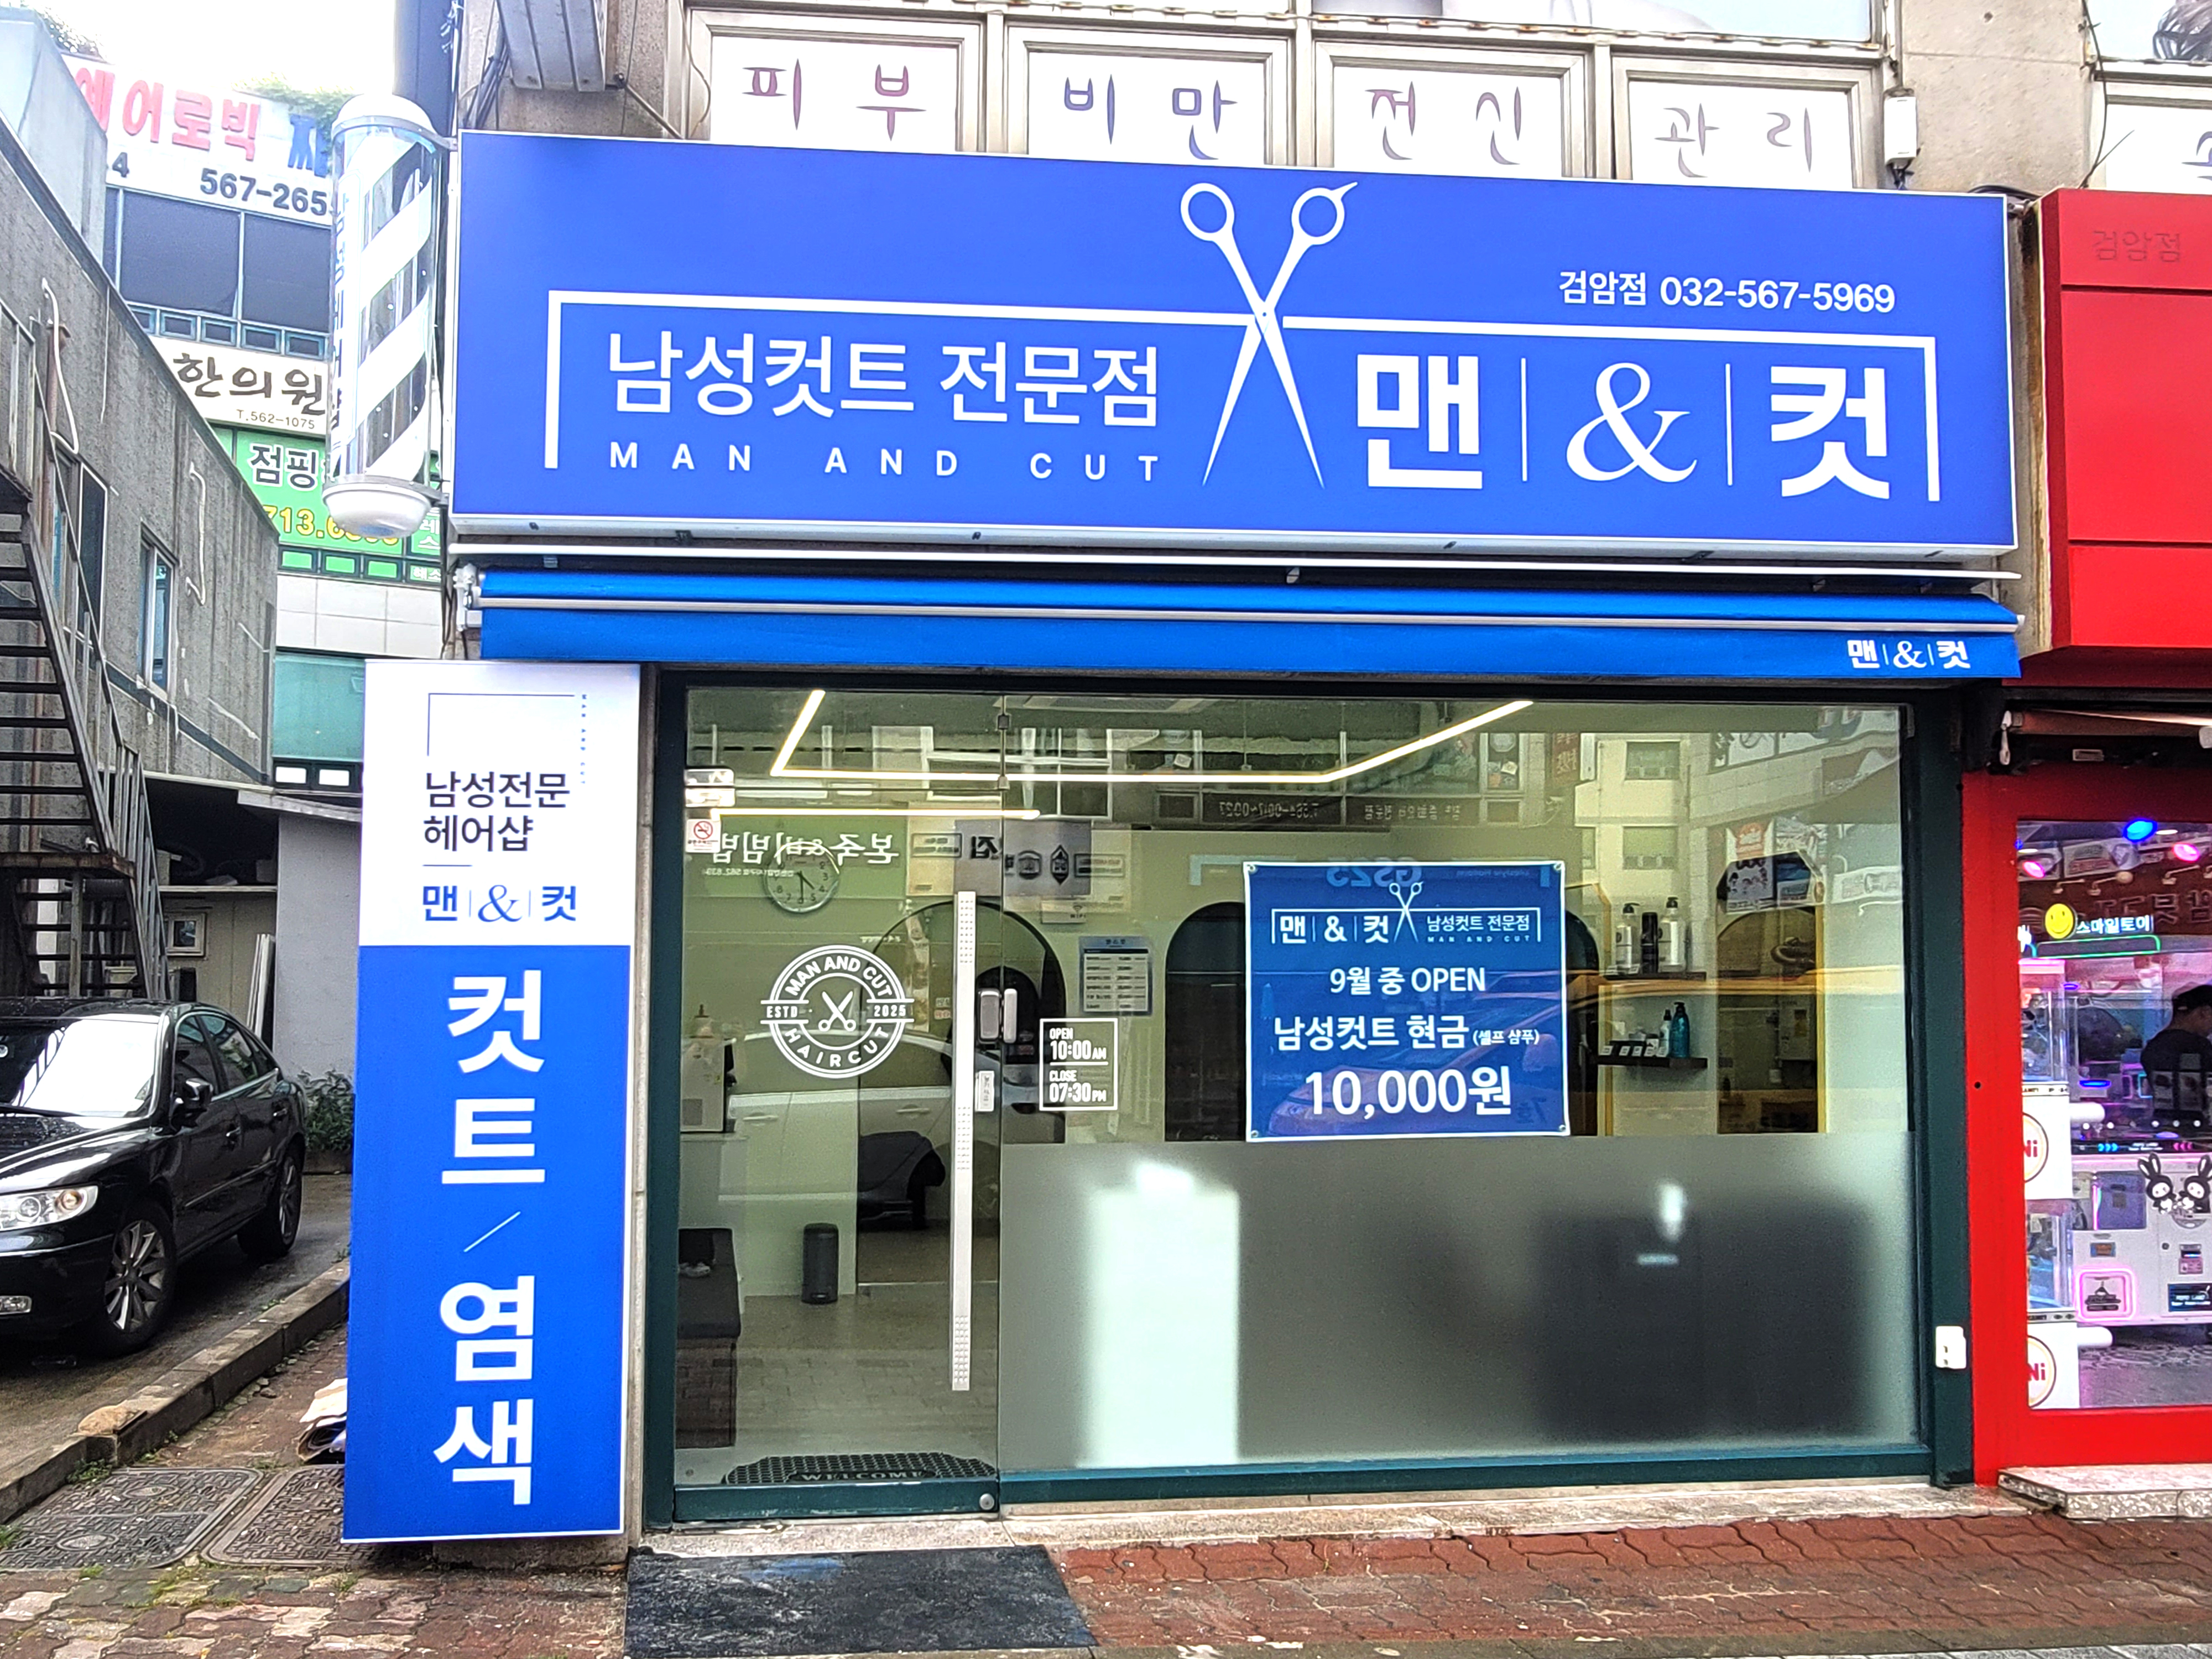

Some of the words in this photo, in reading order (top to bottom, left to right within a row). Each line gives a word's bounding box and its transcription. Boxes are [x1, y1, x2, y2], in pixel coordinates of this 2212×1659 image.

[743, 59, 926, 141] 피부
[1063, 74, 1238, 160] 비만
[1365, 81, 1522, 165] 전신
[1655, 103, 1812, 178] 관리
[200, 168, 331, 217] 567-265
[1559, 270, 1646, 305] 검암점
[1660, 276, 1895, 313] 032-567-5969
[173, 352, 326, 416] 한의원
[236, 408, 316, 430] T.562-1075
[609, 331, 914, 418] 남성컷트
[940, 342, 1156, 426] 전문점
[1357, 354, 1483, 489] 맨
[1567, 362, 1697, 482] &
[1771, 366, 1890, 499] 컷
[250, 444, 325, 490] 점핑
[610, 441, 750, 471] MAN
[825, 447, 957, 476] AND
[1030, 453, 1158, 481] CUT
[1847, 640, 1880, 669] 맨
[1893, 641, 1927, 668] &
[1936, 641, 1970, 669] 컷
[426, 771, 571, 808] 남성전문
[423, 814, 534, 852] 헤어샵
[422, 885, 458, 922] 맨
[477, 884, 522, 923] &
[541, 885, 577, 922] 컷
[1280, 916, 1306, 943] 맨
[1324, 916, 1347, 942] &
[1364, 915, 1388, 943] 컷
[1426, 913, 1484, 933] 남성컷트
[1486, 913, 1530, 933] 전문점
[2076, 915, 2150, 934] 스마일토이
[785, 961, 822, 996] MAN
[824, 956, 860, 971] AND
[863, 966, 893, 996] CUT
[1330, 967, 1371, 995] 9월
[1378, 967, 1405, 995] 중
[1411, 967, 1486, 992] OPEN
[766, 1005, 799, 1018] ESTD
[873, 1005, 907, 1017] 2025
[785, 1026, 889, 1067] HAIRCUT
[1049, 1027, 1073, 1040] OPEN
[1050, 1040, 1092, 1060] 10:00
[1092, 1047, 1107, 1060] AM
[1274, 1015, 1400, 1051] 남성컷트
[1406, 1015, 1469, 1048] 현금
[1472, 1029, 1505, 1046] (셀프
[1507, 1029, 1540, 1045] 샴푸)
[442, 970, 545, 1184] 컷트
[1049, 1070, 1077, 1082] CLOSE
[1049, 1082, 1092, 1103] 07:30
[1092, 1091, 1107, 1102] PM
[1305, 1065, 1512, 1120] 10,000원
[434, 1276, 535, 1505] 염색
